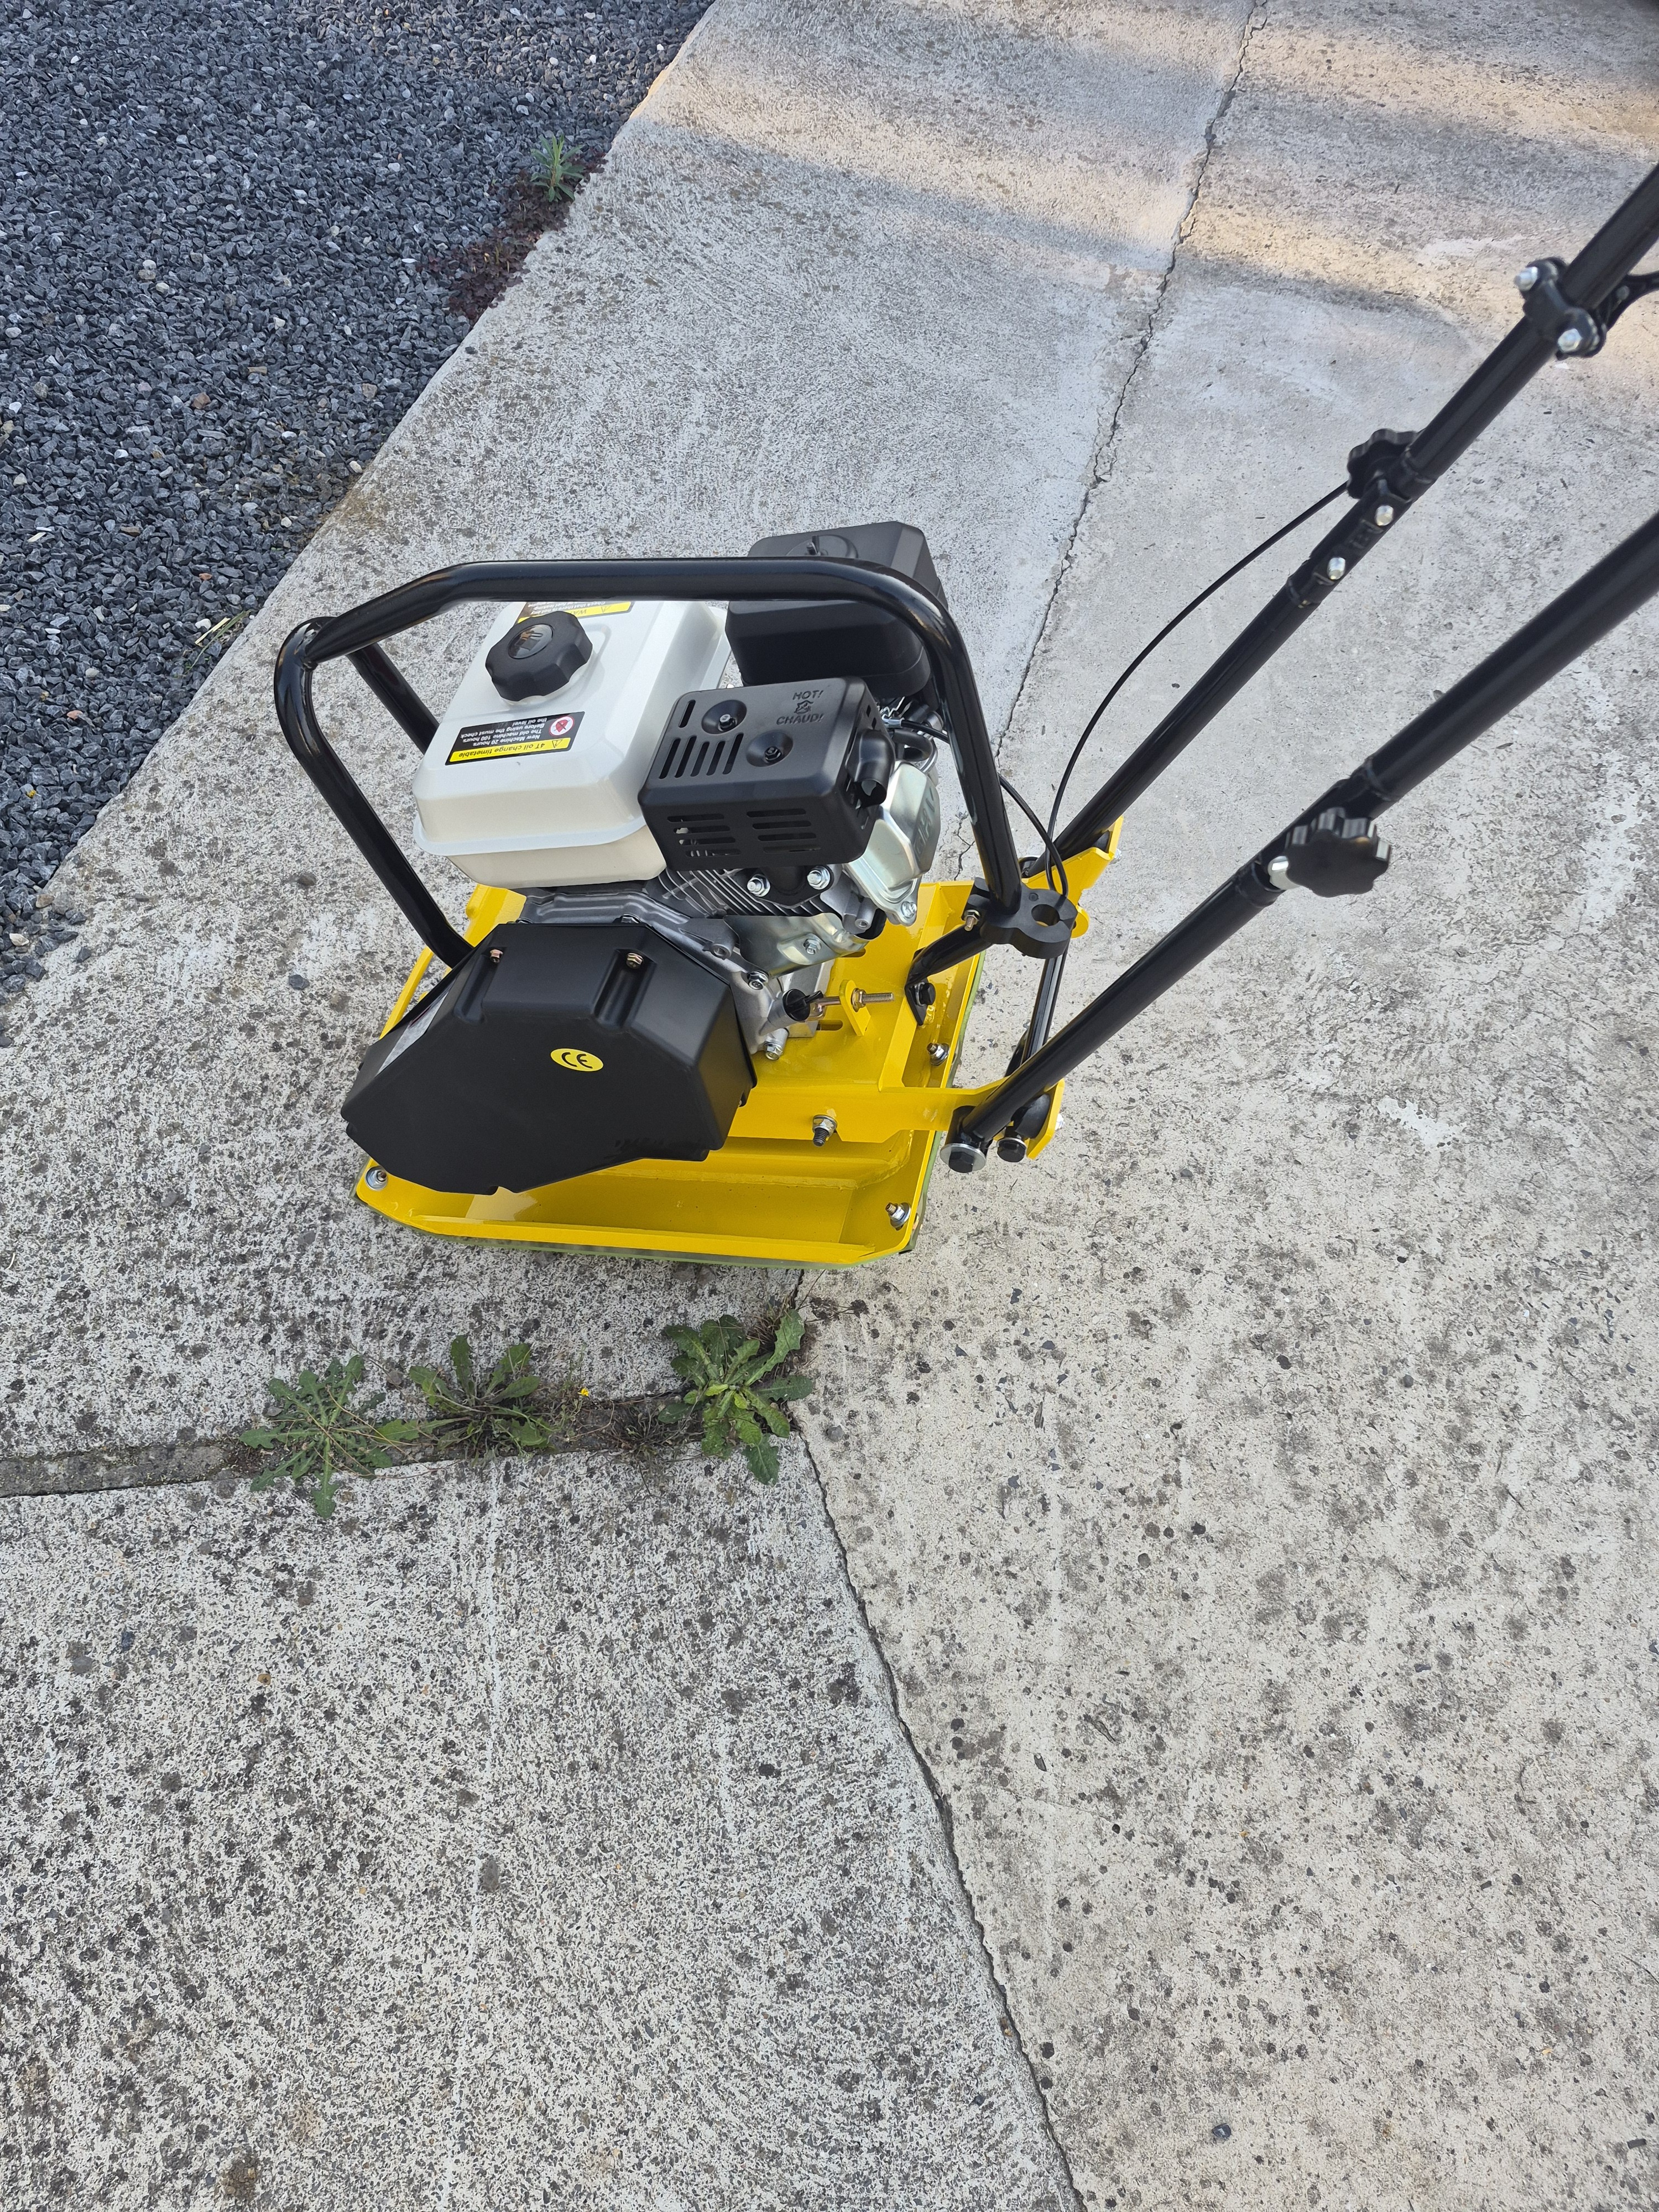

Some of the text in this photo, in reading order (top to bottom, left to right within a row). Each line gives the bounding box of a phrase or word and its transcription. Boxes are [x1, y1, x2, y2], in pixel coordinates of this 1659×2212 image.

[792, 690, 824, 700] HOT!
[776, 713, 824, 725] CHAUD!
[458, 749, 492, 758] timetable
[561, 1052, 593, 1069] CE
